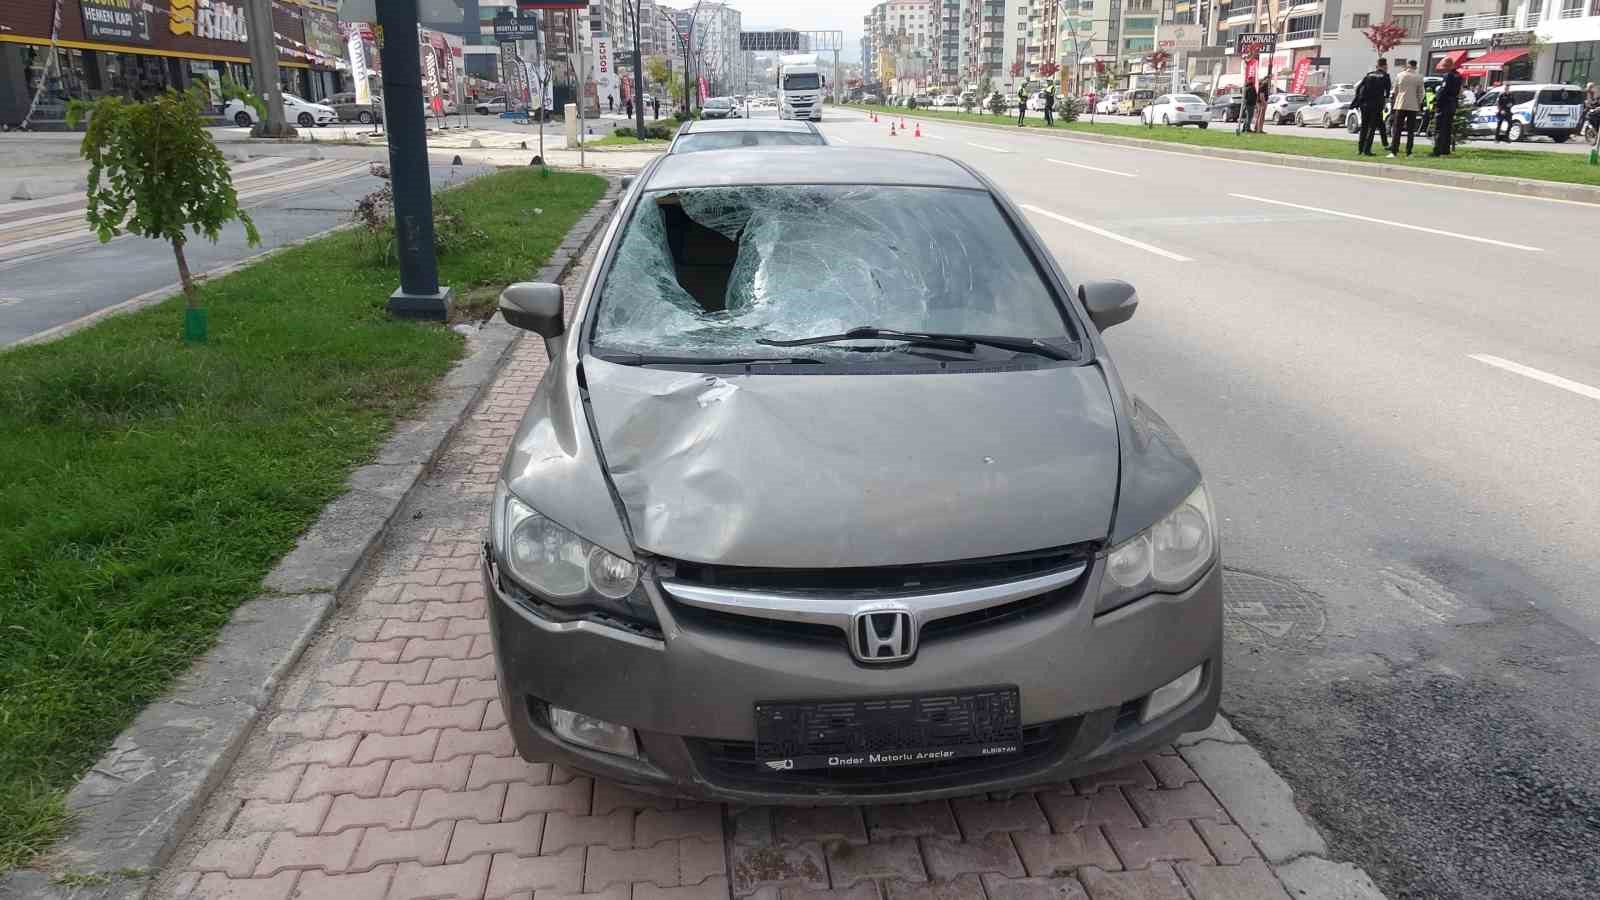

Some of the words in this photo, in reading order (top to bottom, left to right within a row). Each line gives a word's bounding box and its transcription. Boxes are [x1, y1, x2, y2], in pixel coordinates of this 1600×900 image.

[85, 7, 114, 24] HEMEN
[599, 42, 608, 73] BOSCH
[869, 752, 913, 763] Motorlu
